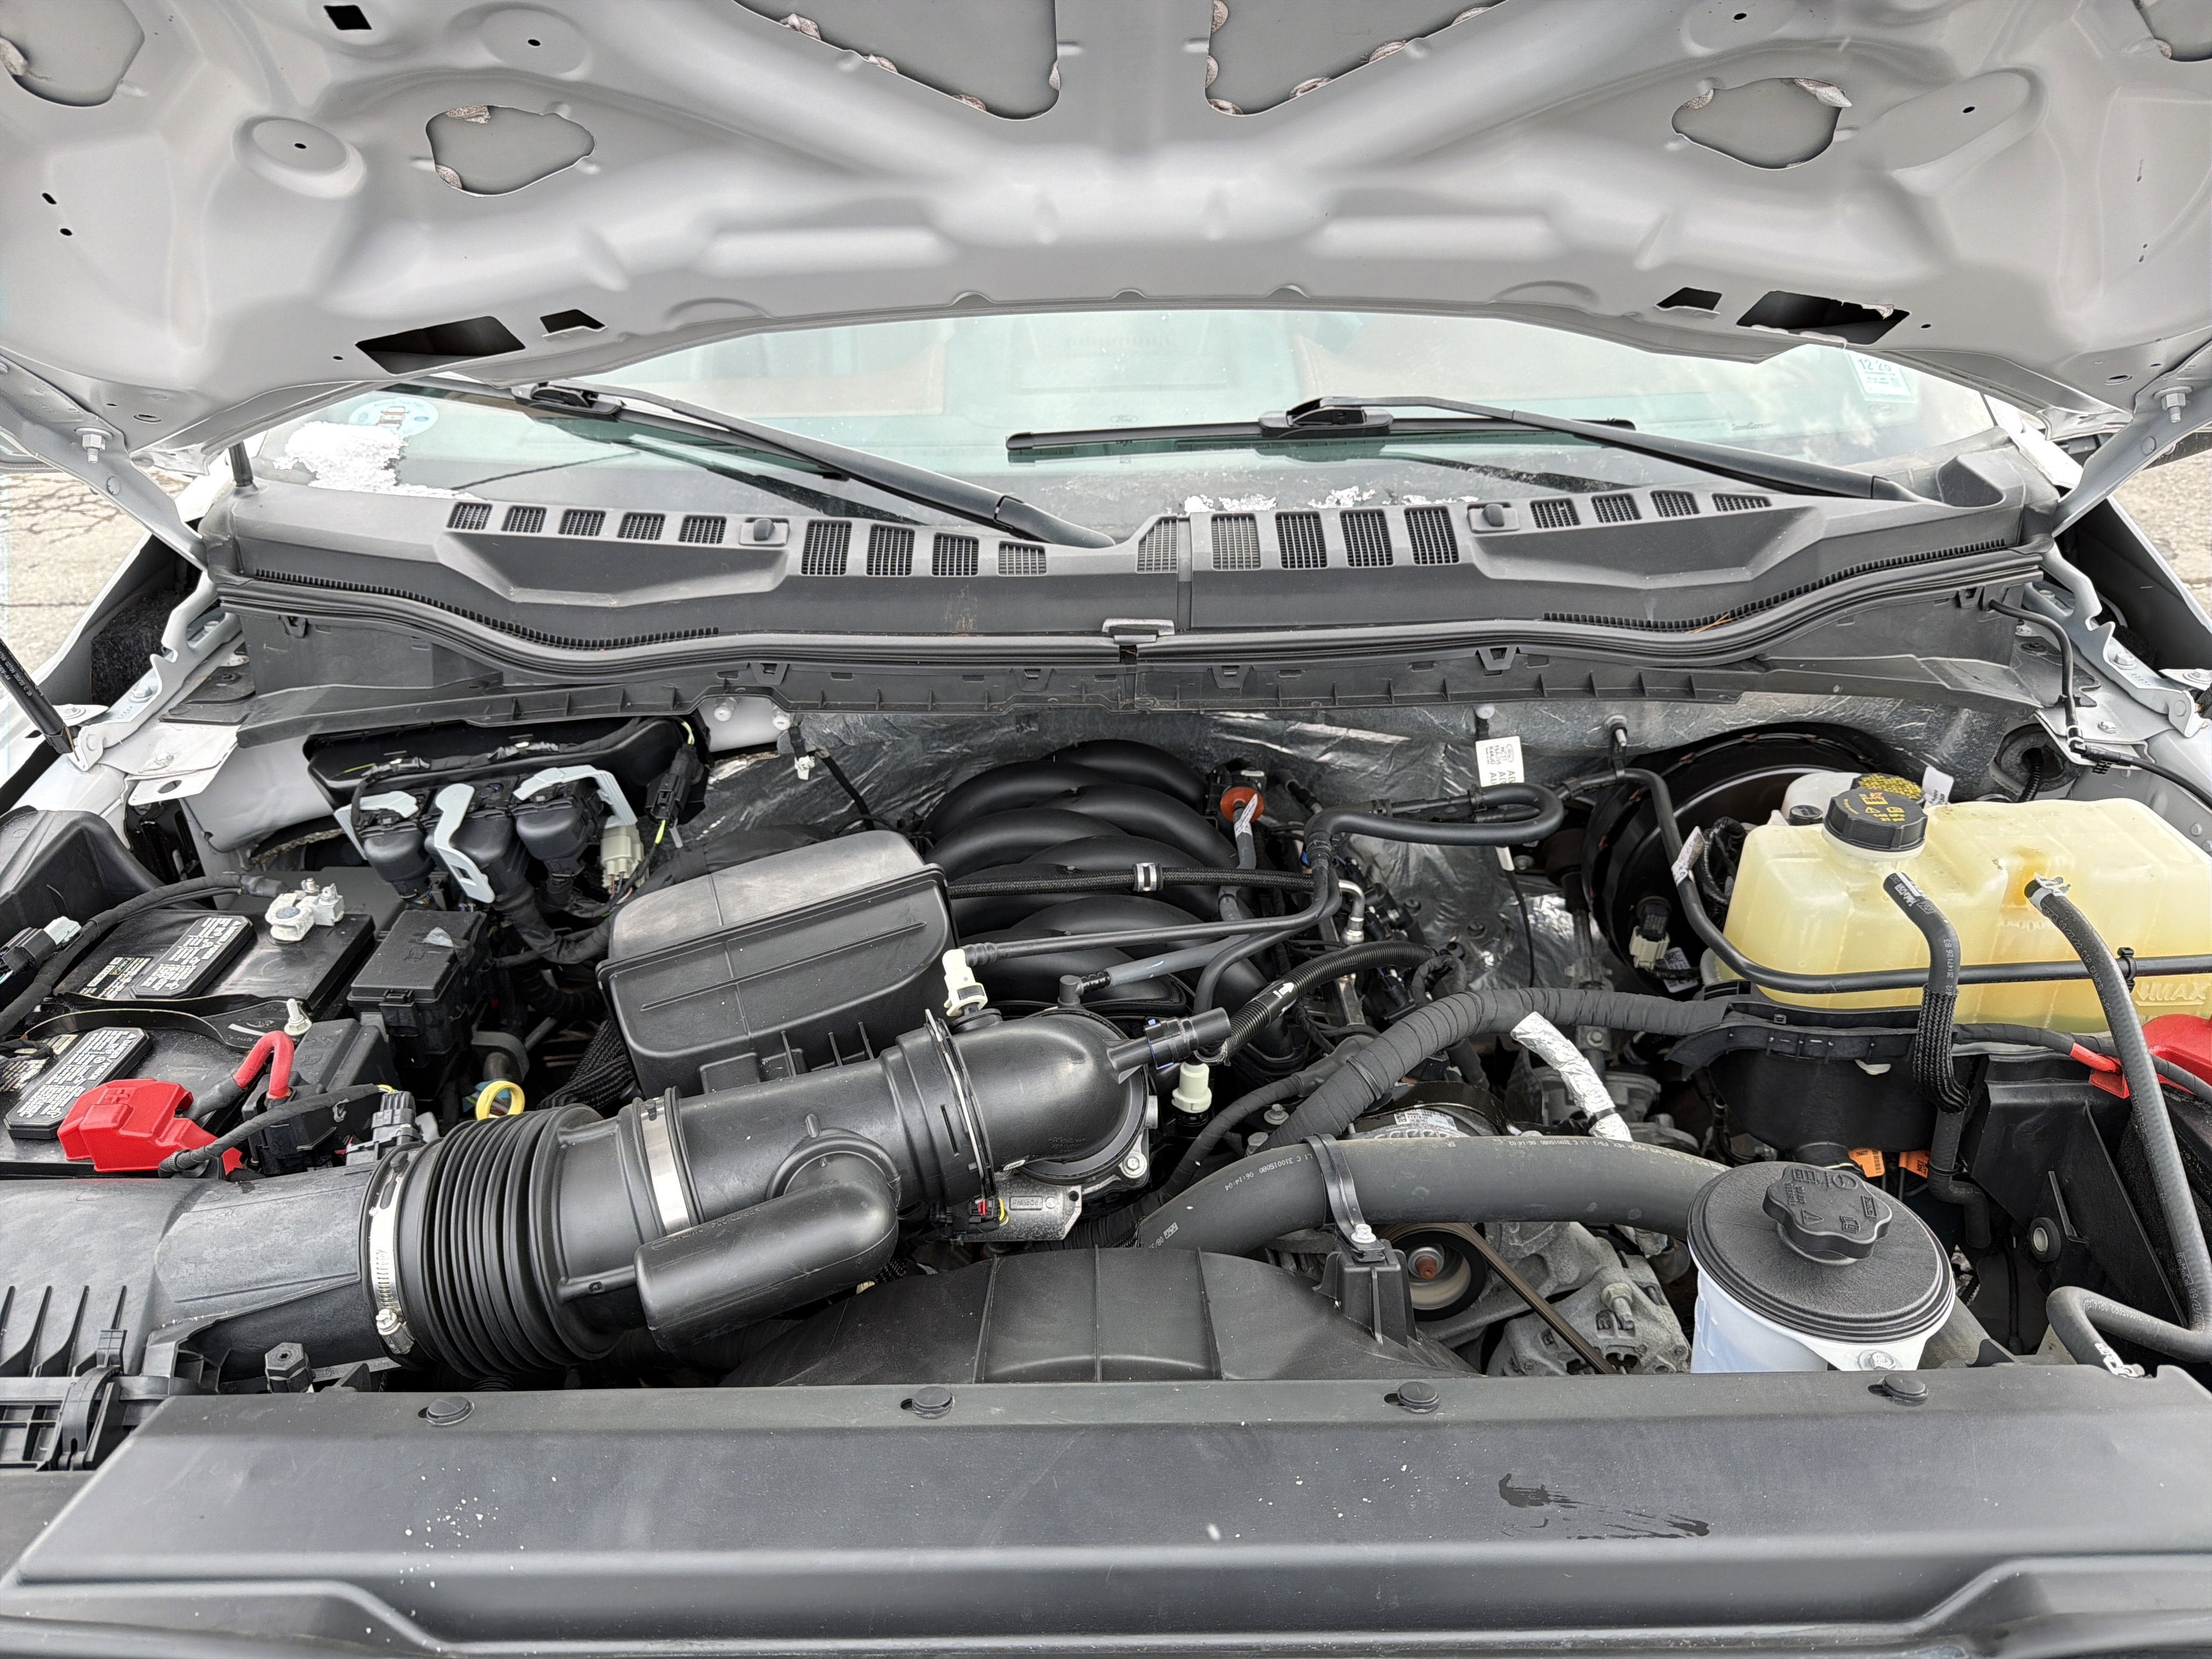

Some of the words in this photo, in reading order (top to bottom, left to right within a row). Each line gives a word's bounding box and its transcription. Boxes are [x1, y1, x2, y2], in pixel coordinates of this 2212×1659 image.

[1858, 359, 1874, 370] 12
[1943, 938, 1952, 948] B3
[2148, 981, 2211, 1001] MAX
[1304, 1153, 1313, 1161] L1
[1259, 1157, 1294, 1174] 310015080
[1224, 1171, 1254, 1192] 06:14:04
